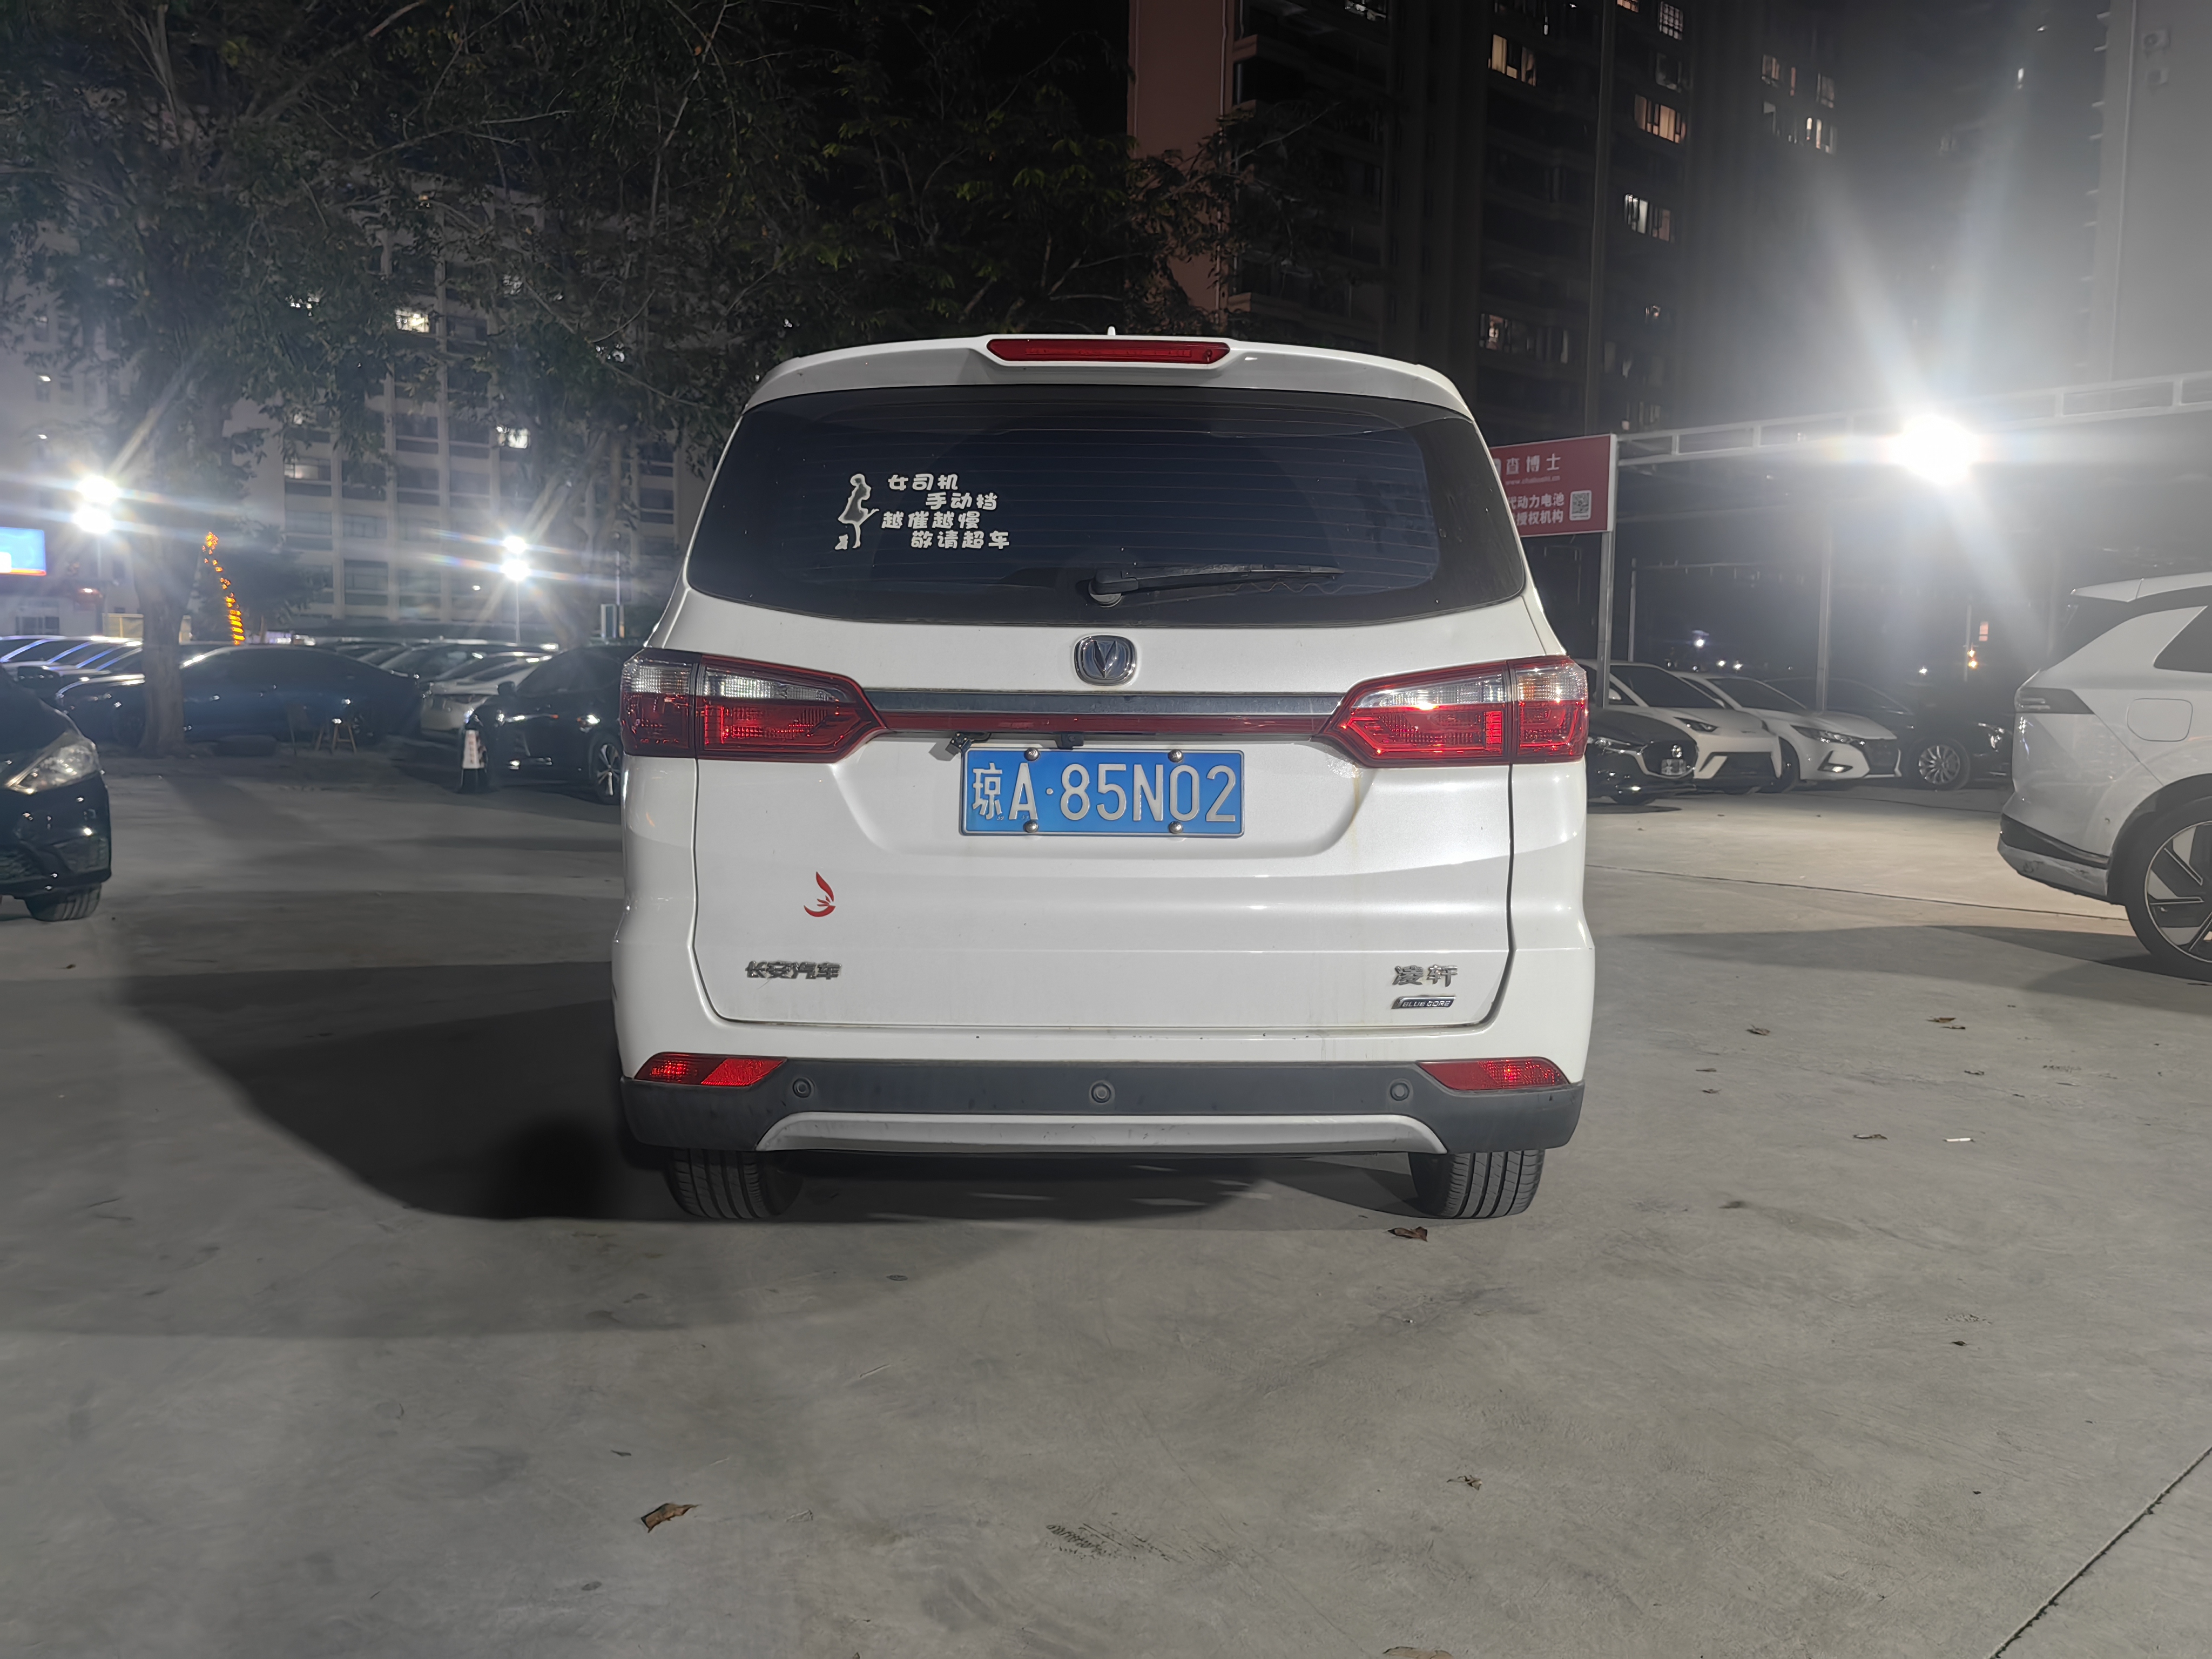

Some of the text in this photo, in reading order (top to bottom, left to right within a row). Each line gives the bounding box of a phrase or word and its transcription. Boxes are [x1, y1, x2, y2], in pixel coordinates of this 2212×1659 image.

[888, 474, 958, 490] 女司机
[926, 491, 997, 510] 手动挡
[881, 511, 980, 529] 越催越慢
[1513, 509, 1563, 525] 授权机构
[911, 530, 1009, 549] 敬请超车
[745, 960, 842, 980] 长安汽车
[1392, 965, 1458, 987] 凌轩
